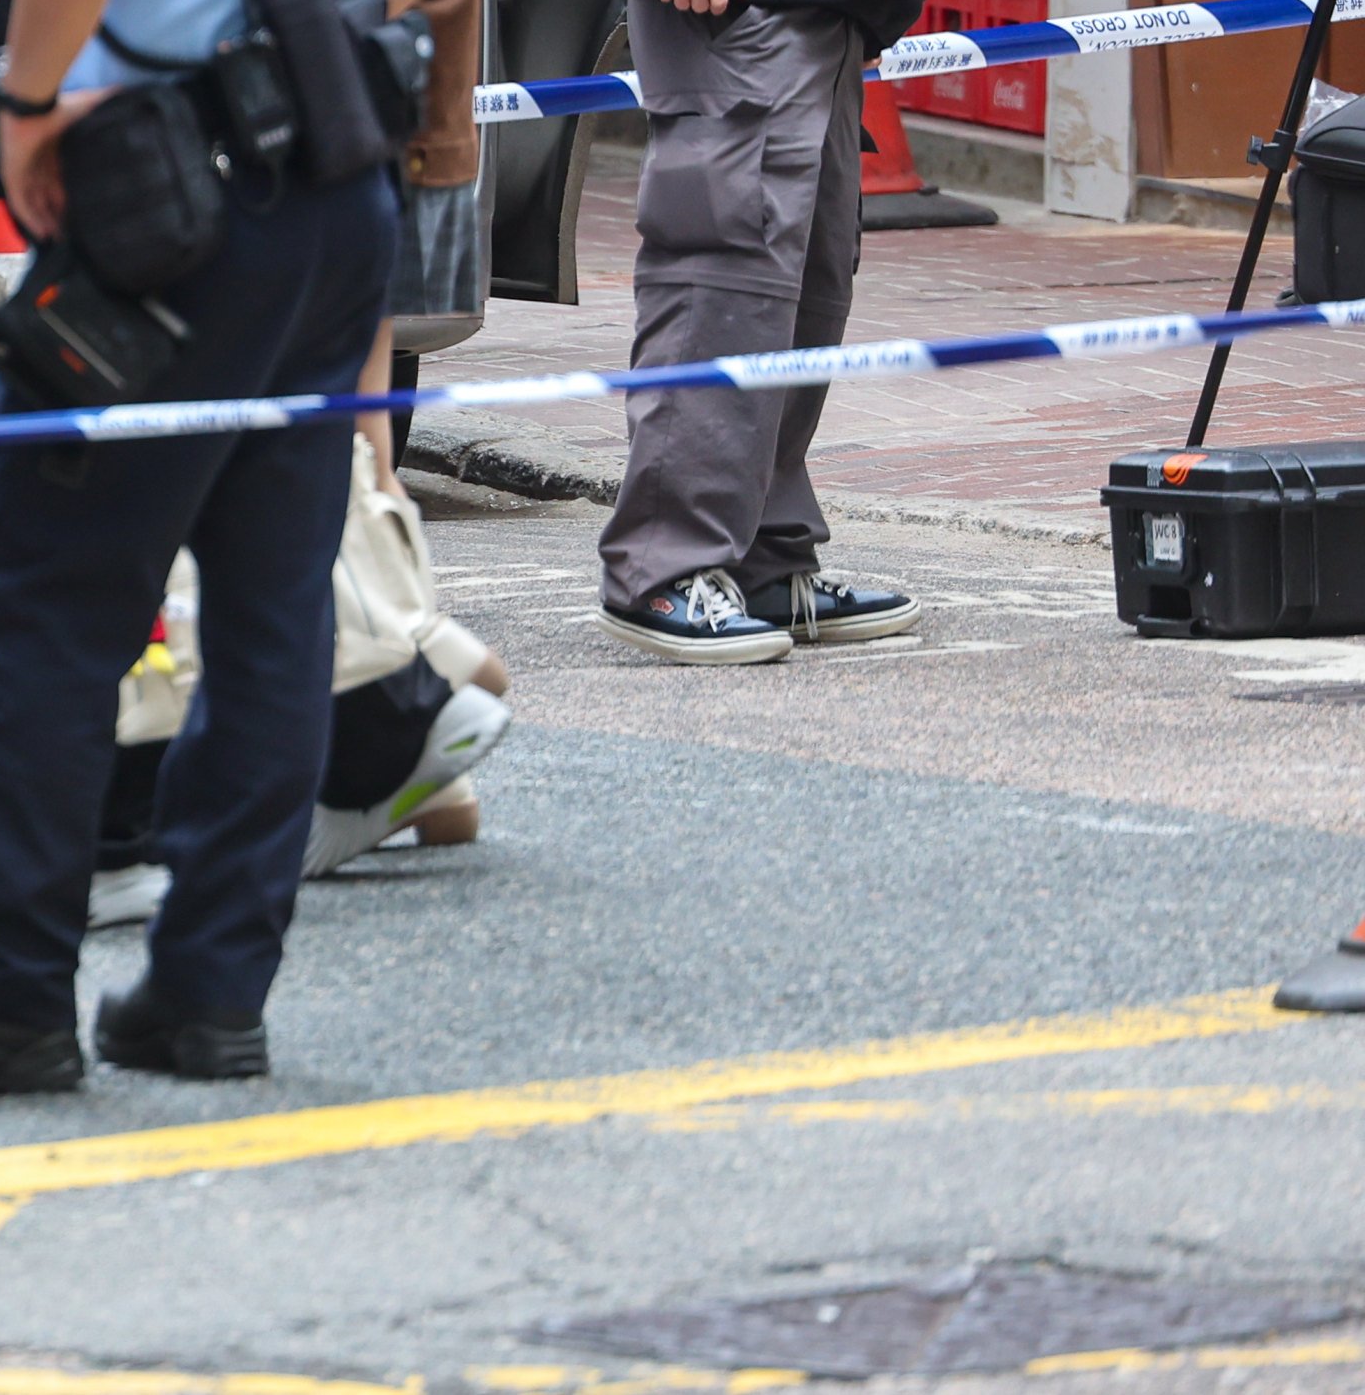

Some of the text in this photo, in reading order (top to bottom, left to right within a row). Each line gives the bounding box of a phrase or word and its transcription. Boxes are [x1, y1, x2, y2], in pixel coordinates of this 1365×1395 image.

[1071, 9, 1190, 35] DO NOT CROSS
